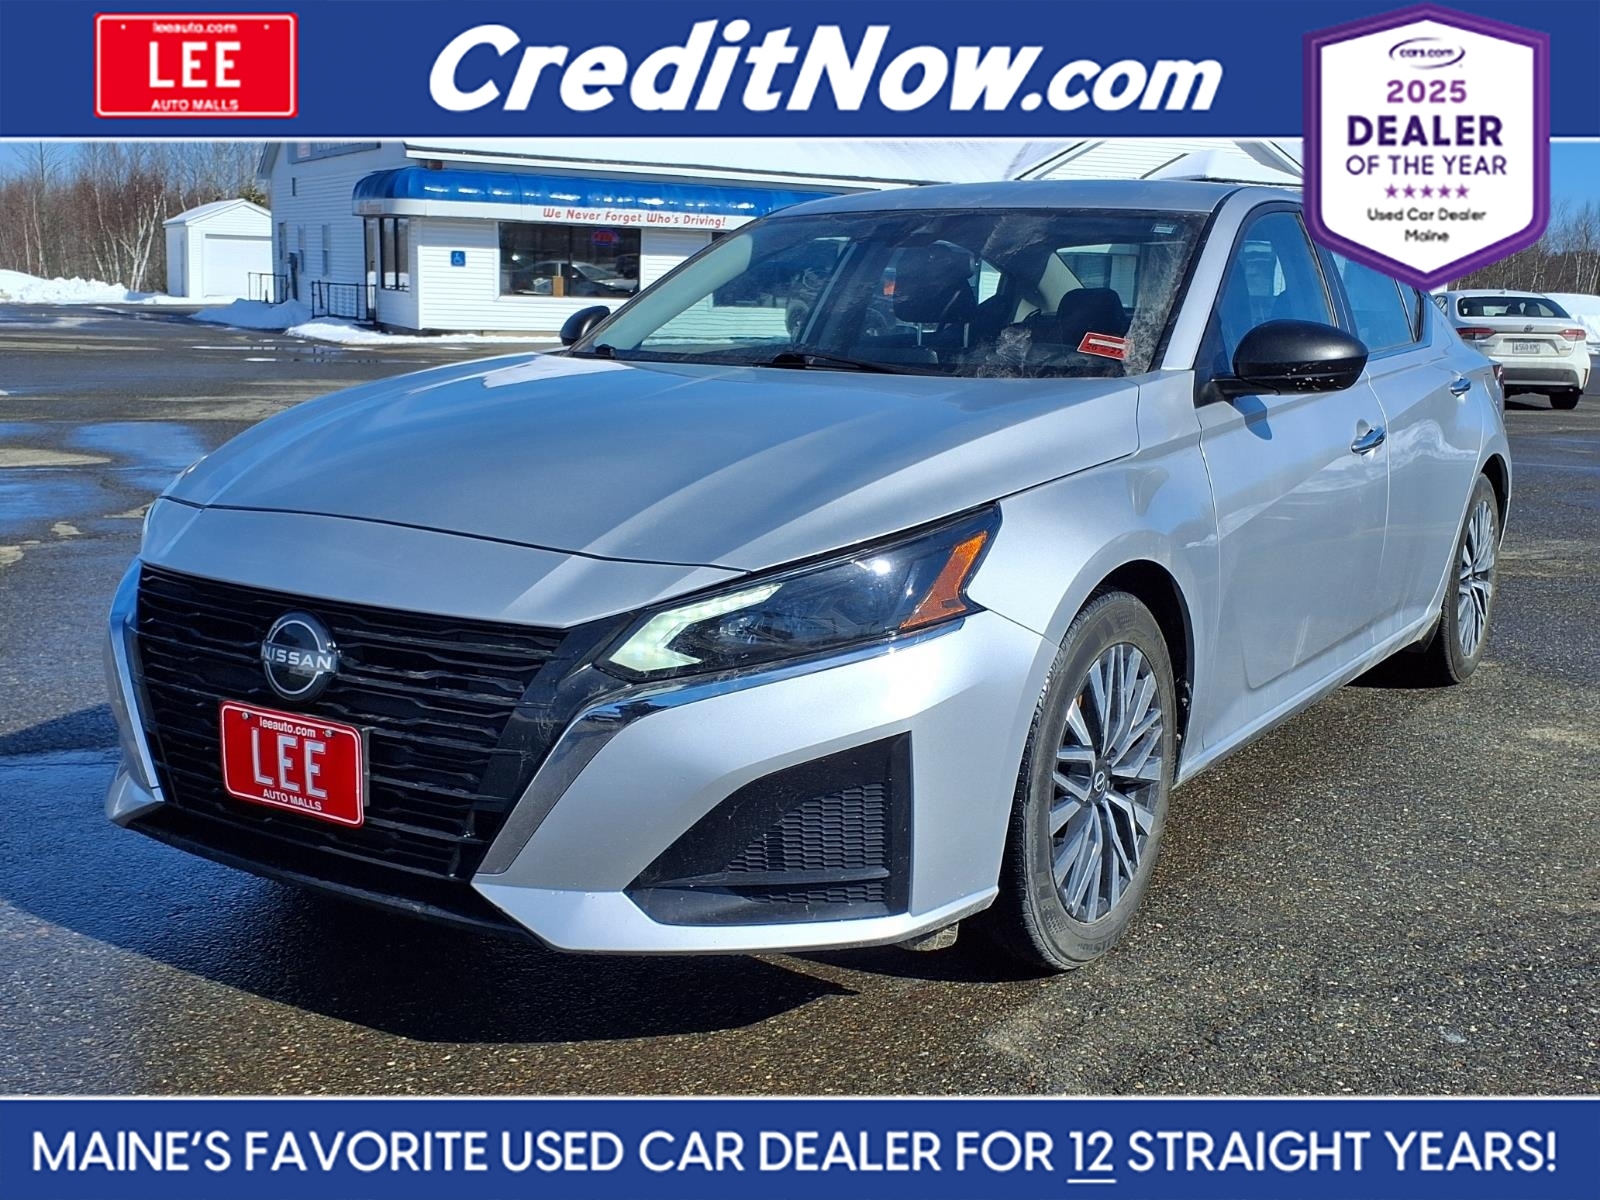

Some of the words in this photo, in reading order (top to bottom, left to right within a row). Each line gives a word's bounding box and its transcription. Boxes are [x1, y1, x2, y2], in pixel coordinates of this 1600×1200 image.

[543, 208, 561, 218] We
[566, 209, 600, 221] Never
[605, 211, 641, 224] Forget
[646, 213, 679, 224] Who's
[683, 215, 726, 229] Driving!
[262, 646, 331, 669] NISSAN
[259, 716, 316, 738] leeauto.com
[252, 728, 327, 799] LEE
[263, 788, 288, 803] AUTO
[290, 794, 322, 811] MALLS
